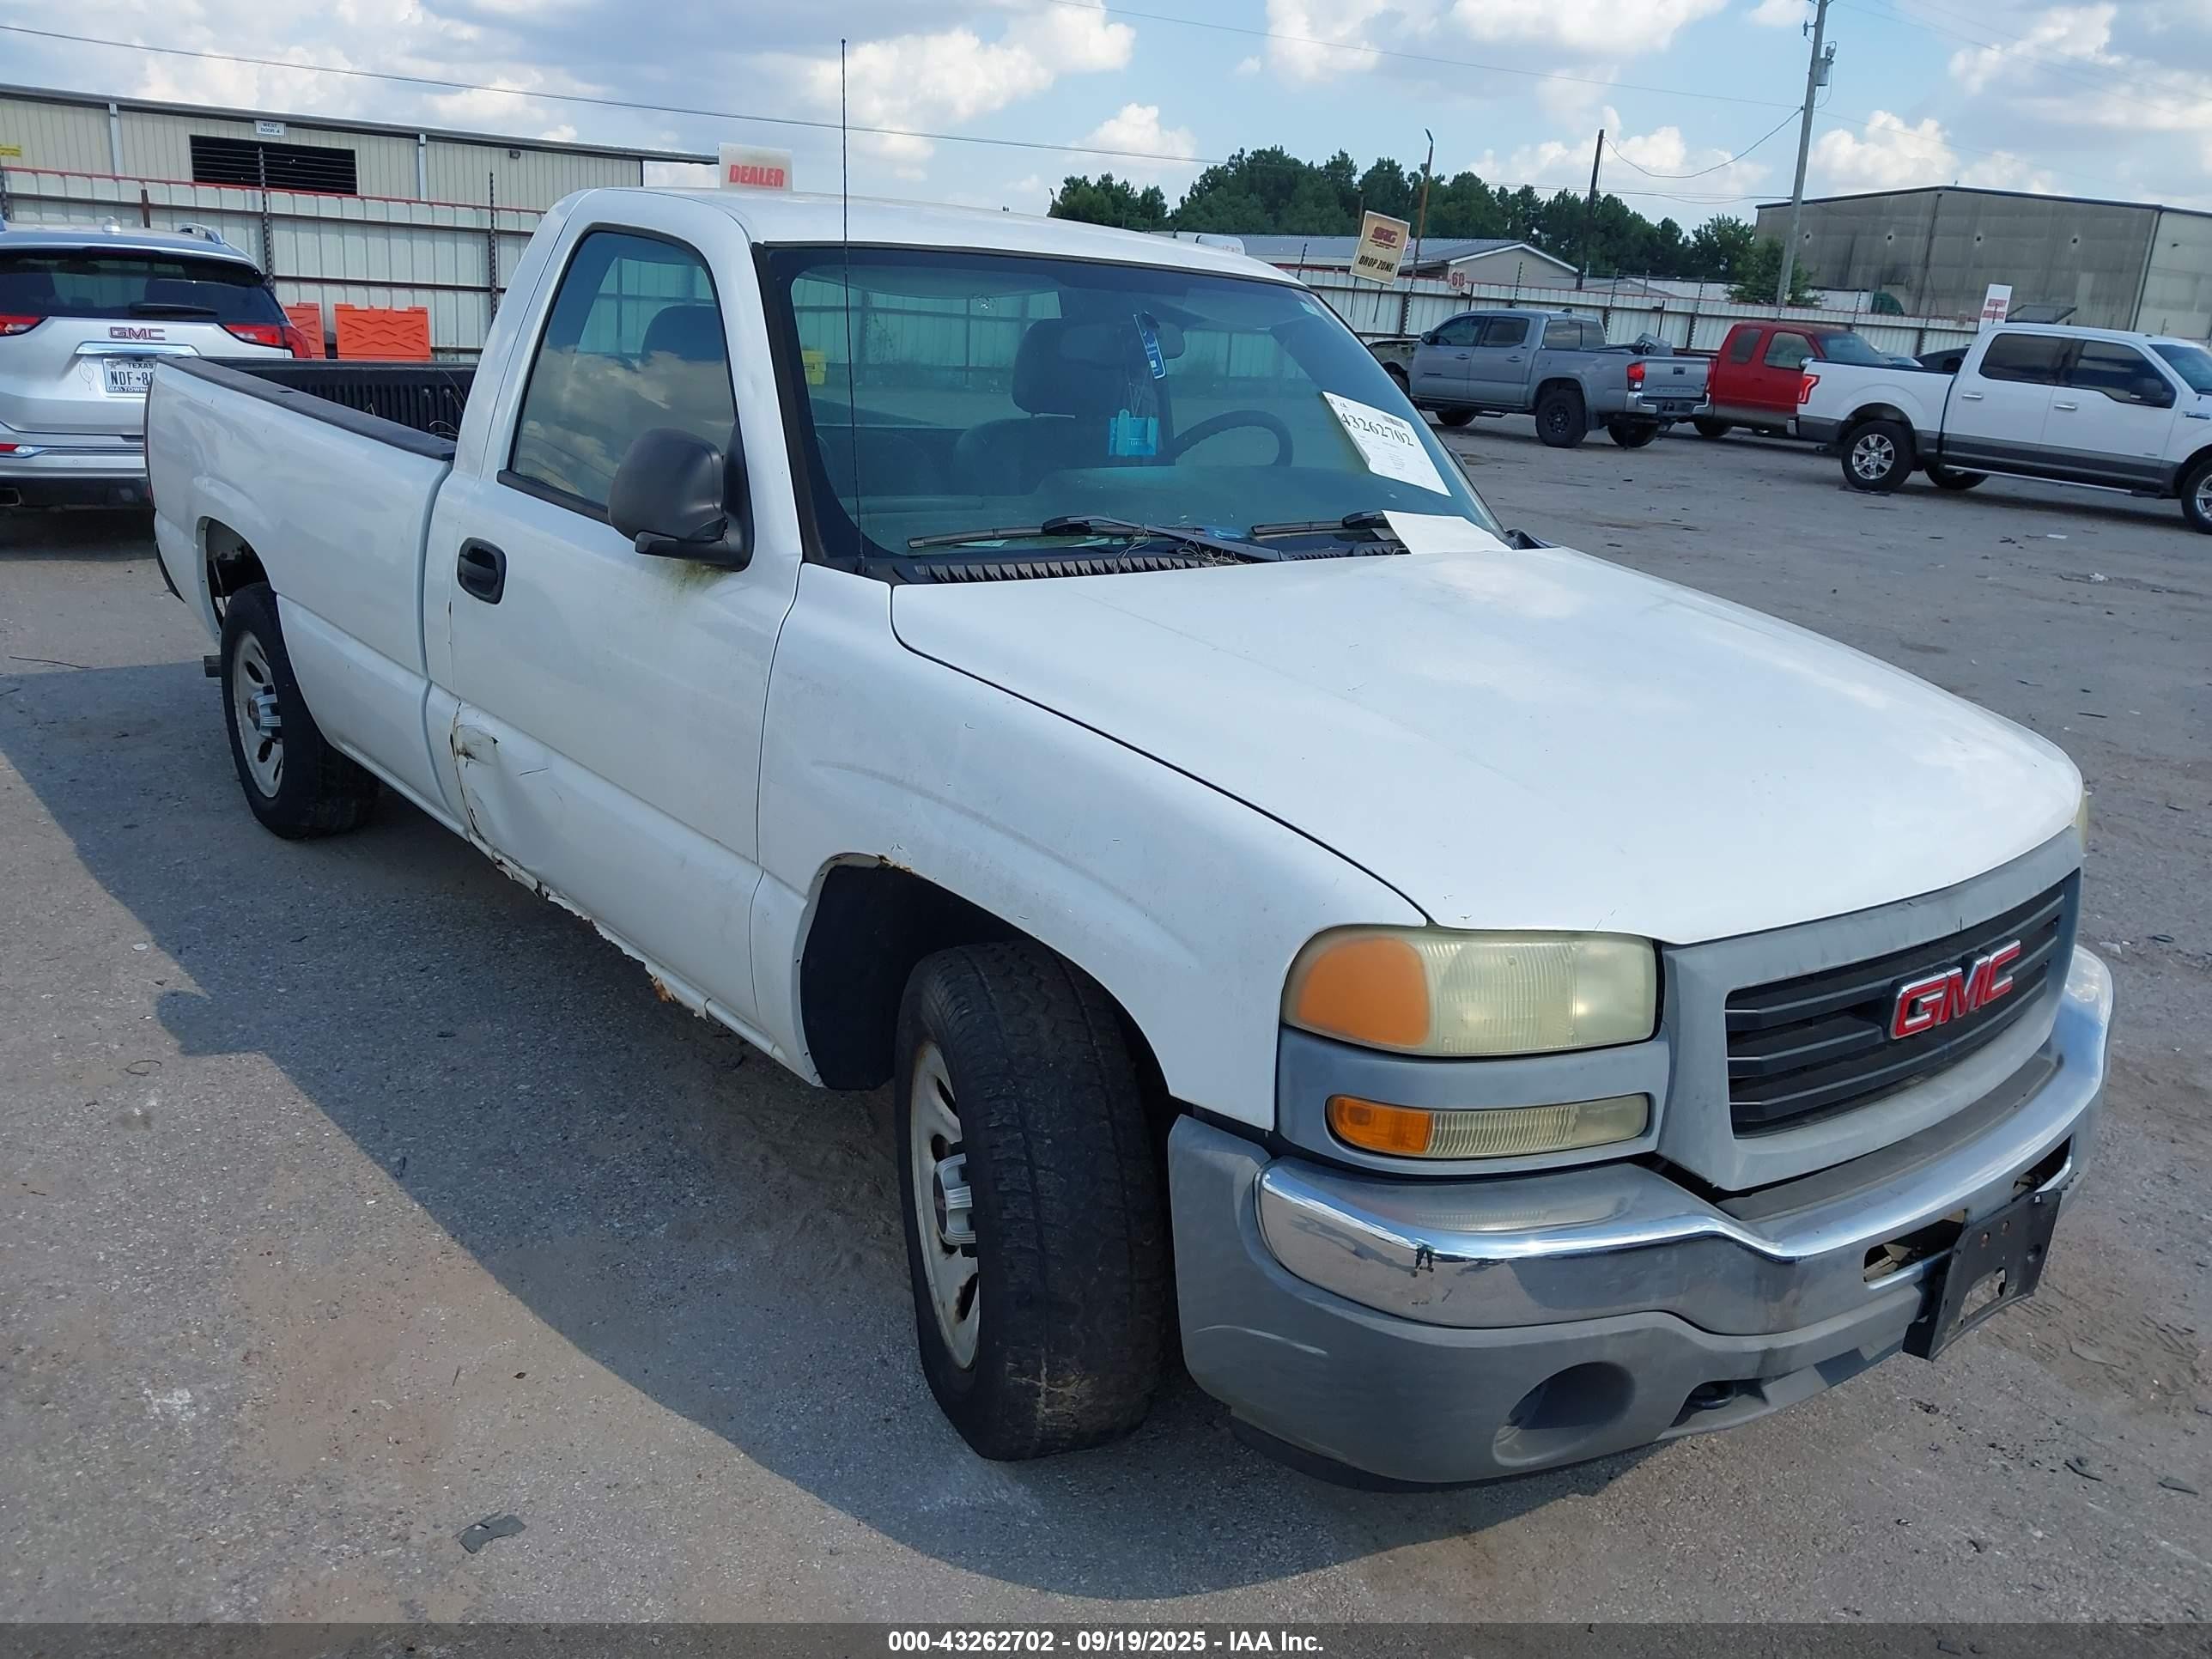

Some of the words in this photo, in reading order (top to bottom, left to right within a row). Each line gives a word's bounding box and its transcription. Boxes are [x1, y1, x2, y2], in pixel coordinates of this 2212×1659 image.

[729, 164, 785, 187] DEALER
[1358, 255, 1378, 268] DROP
[1376, 260, 1395, 272] ZONE
[1451, 272, 1465, 288] 60
[109, 326, 166, 341] GMC
[1340, 412, 1415, 447] 43262702
[1891, 939, 2021, 1040] GMC
